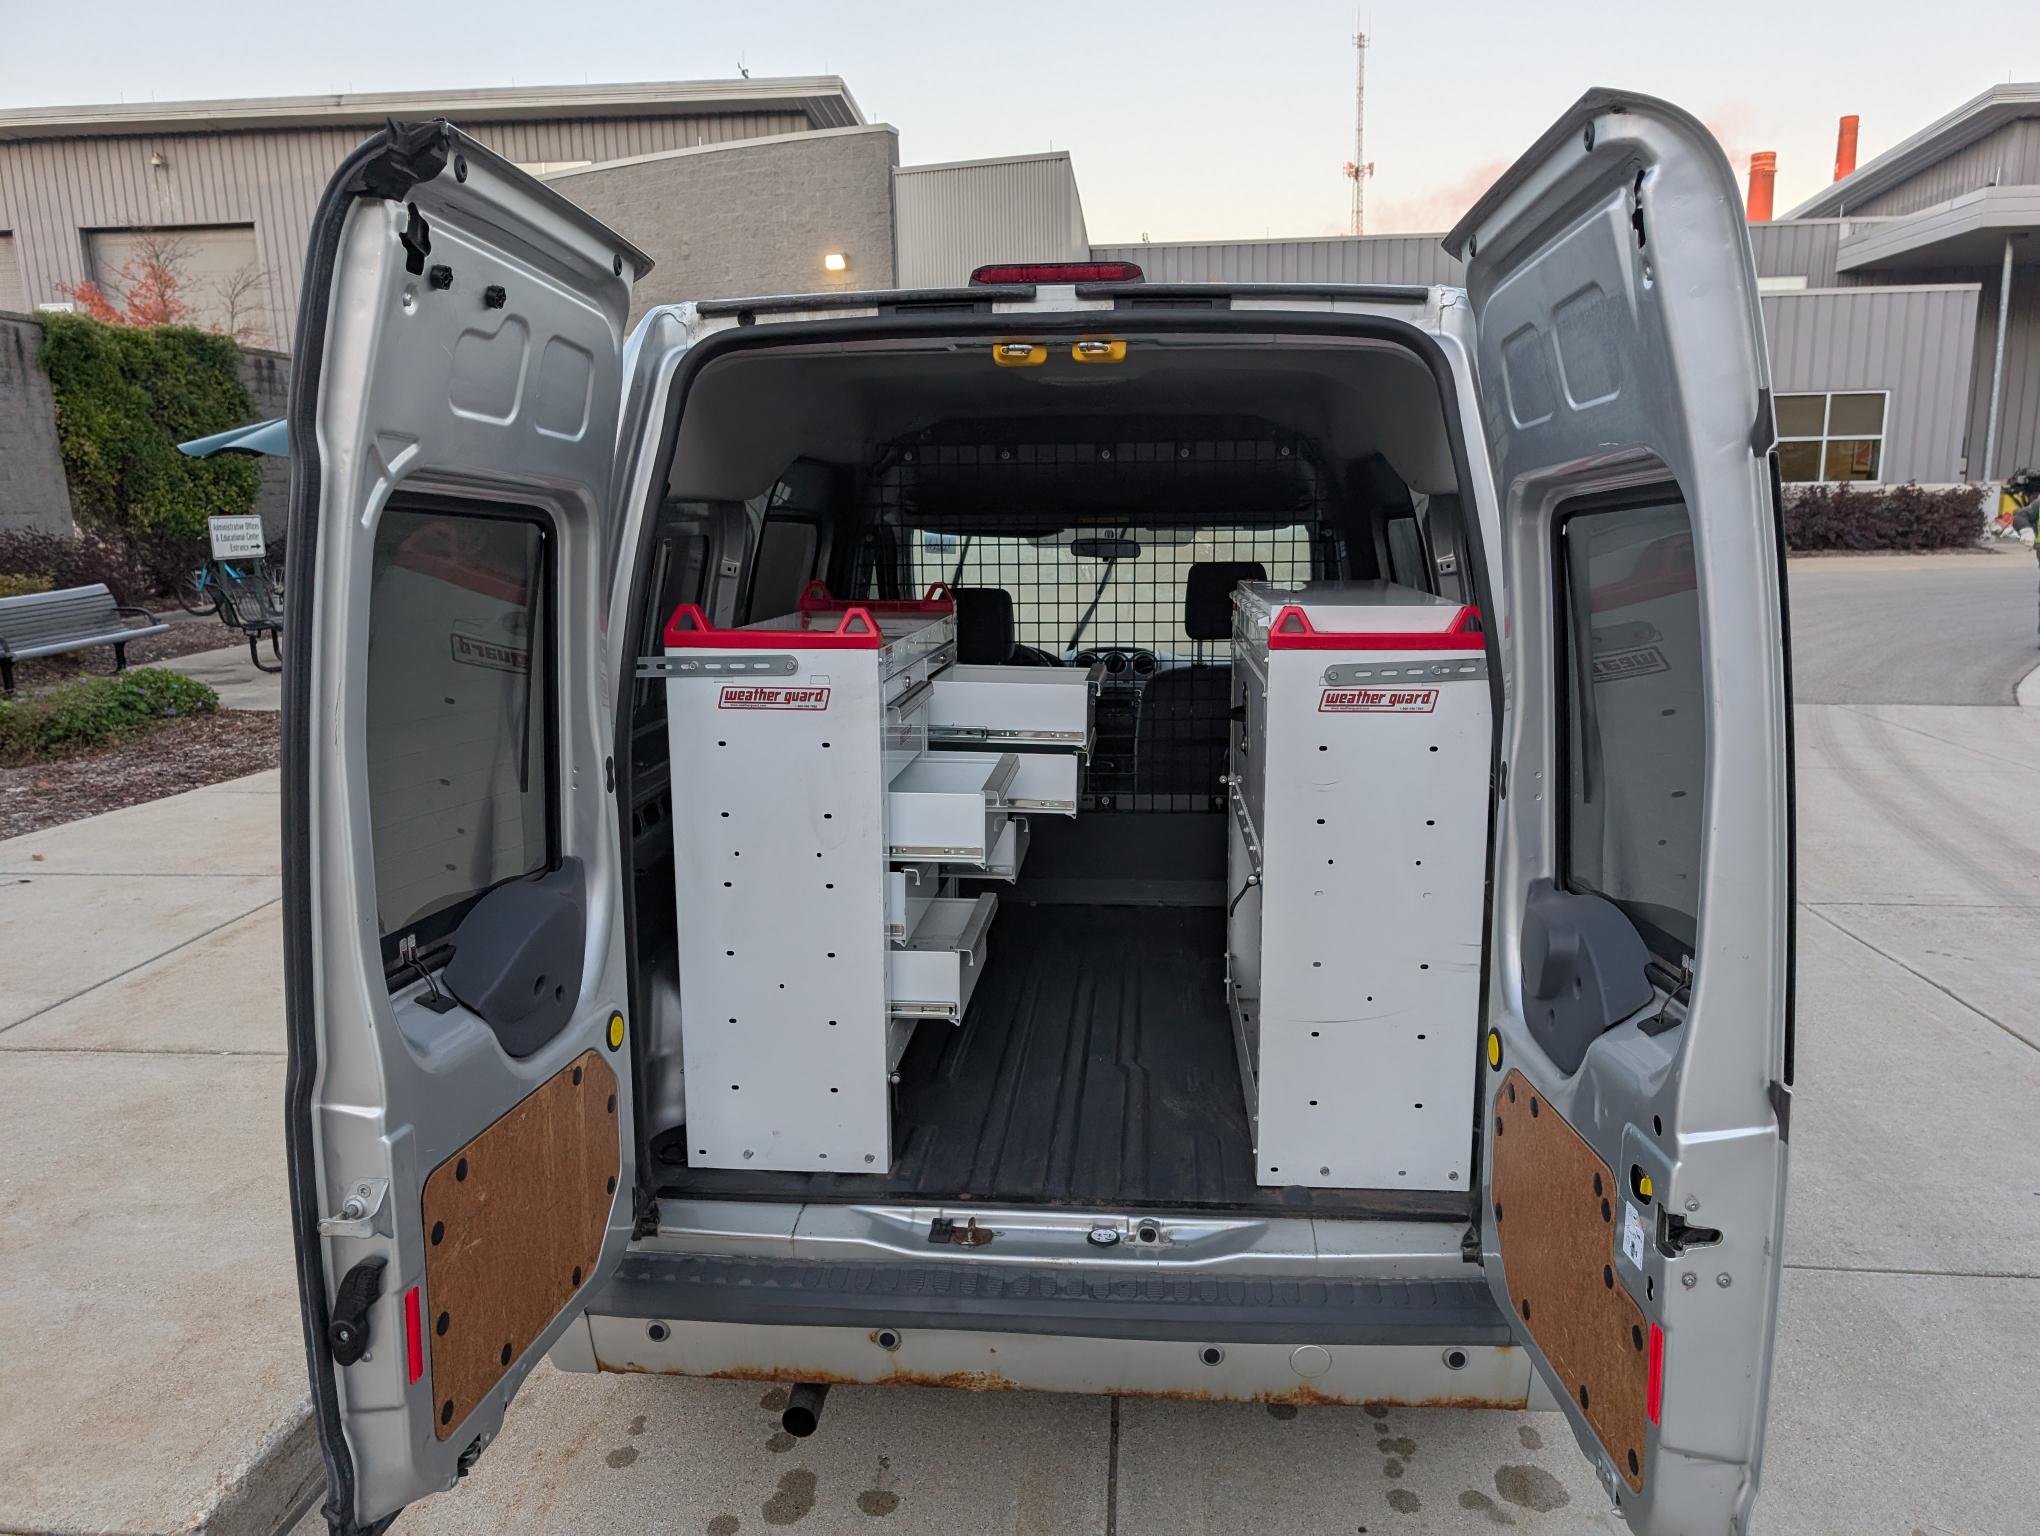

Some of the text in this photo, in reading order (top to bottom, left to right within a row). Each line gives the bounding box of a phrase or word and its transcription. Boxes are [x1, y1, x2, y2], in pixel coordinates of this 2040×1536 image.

[213, 522, 259, 531] Administrative Offices
[220, 533, 245, 542] Educational
[246, 532, 260, 541] Center
[230, 543, 249, 552] Entrance
[724, 688, 824, 704] weather guard
[1325, 689, 1432, 705] weather guard
